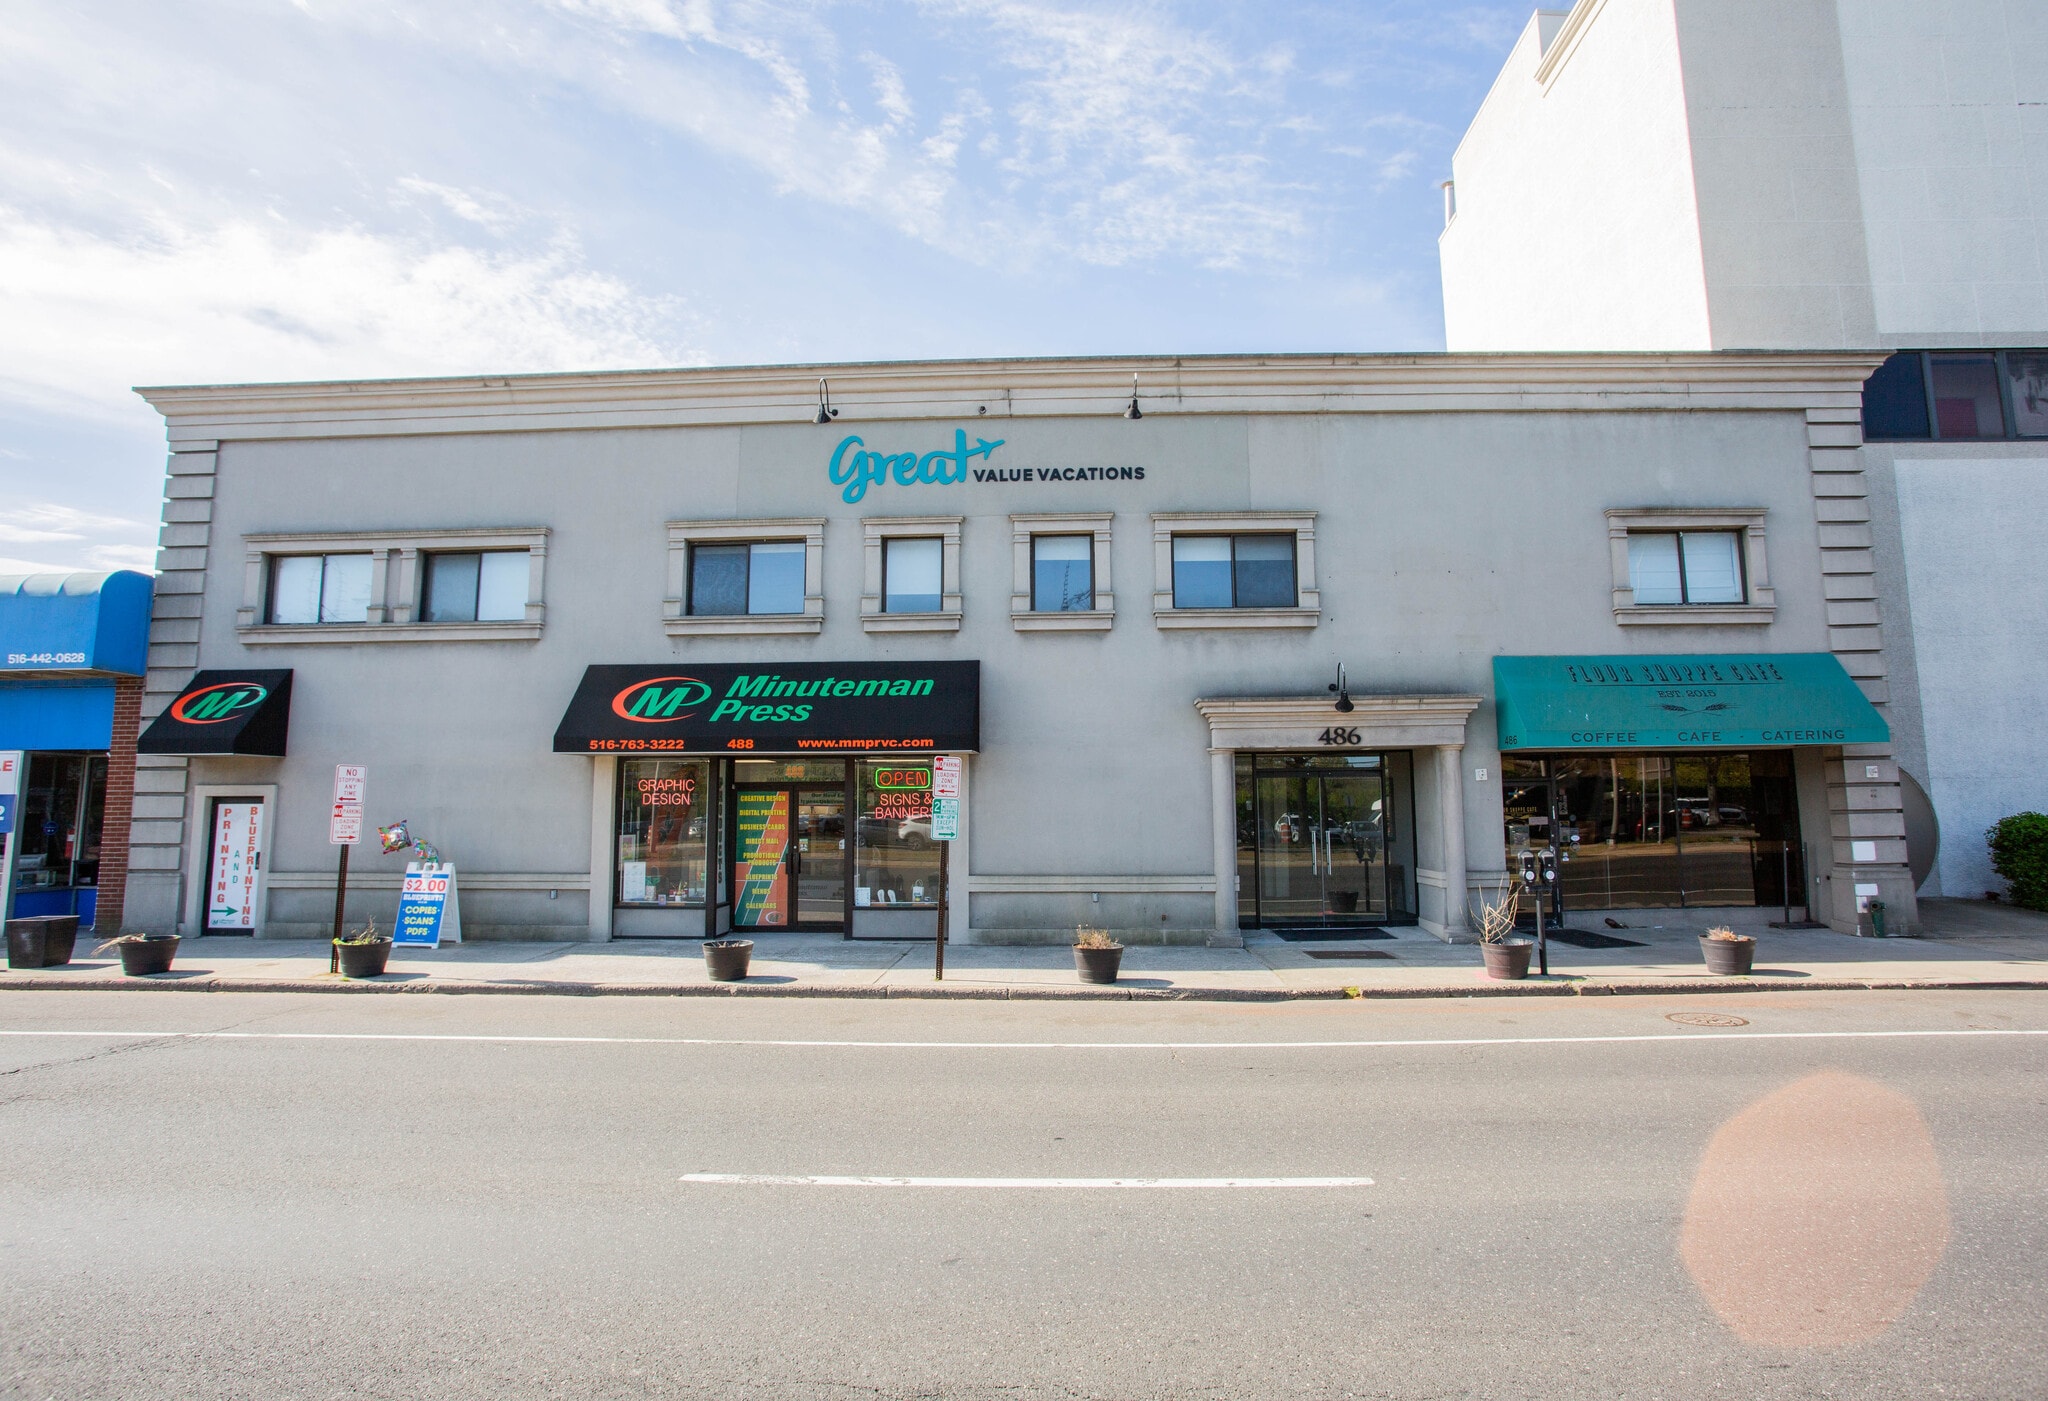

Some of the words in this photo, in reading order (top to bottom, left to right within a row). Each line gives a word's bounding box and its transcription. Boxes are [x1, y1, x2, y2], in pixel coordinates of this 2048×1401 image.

[829, 428, 969, 504] Great
[973, 468, 1033, 483] VALUE
[1037, 466, 1145, 482] VACATIONS
[8, 652, 86, 664] 516-442-0628
[1566, 664, 1633, 682] FLOUR
[1640, 664, 1723, 682] SHOPPE
[1728, 663, 1784, 681] CAFE
[725, 675, 935, 698] Minuteman
[708, 699, 813, 722] Press
[1318, 726, 1362, 745] 486
[1504, 735, 1518, 745] 486
[1571, 732, 1638, 743] COFFEE
[1677, 731, 1722, 742] CAFE
[1762, 730, 1845, 741] CATERING
[589, 739, 685, 750] 516-763-3222
[727, 738, 754, 749] 488
[797, 737, 935, 750] www.mmprvc.com
[346, 769, 358, 777] NO
[879, 771, 927, 786] OPEN
[638, 779, 695, 792] GRAPHIC
[642, 793, 691, 805] DESIGN
[879, 793, 920, 806] SIGNS
[924, 792, 933, 805] &
[934, 802, 940, 812] 2
[217, 808, 232, 903] PRINTING
[232, 850, 240, 884] AND
[241, 807, 258, 925] BLUEPRINTING
[406, 879, 446, 892] $2.00
[403, 893, 444, 901] BLUEPRINTS
[405, 906, 438, 914] COPIES
[404, 916, 435, 925] SCANS
[406, 927, 428, 935] PDFS
